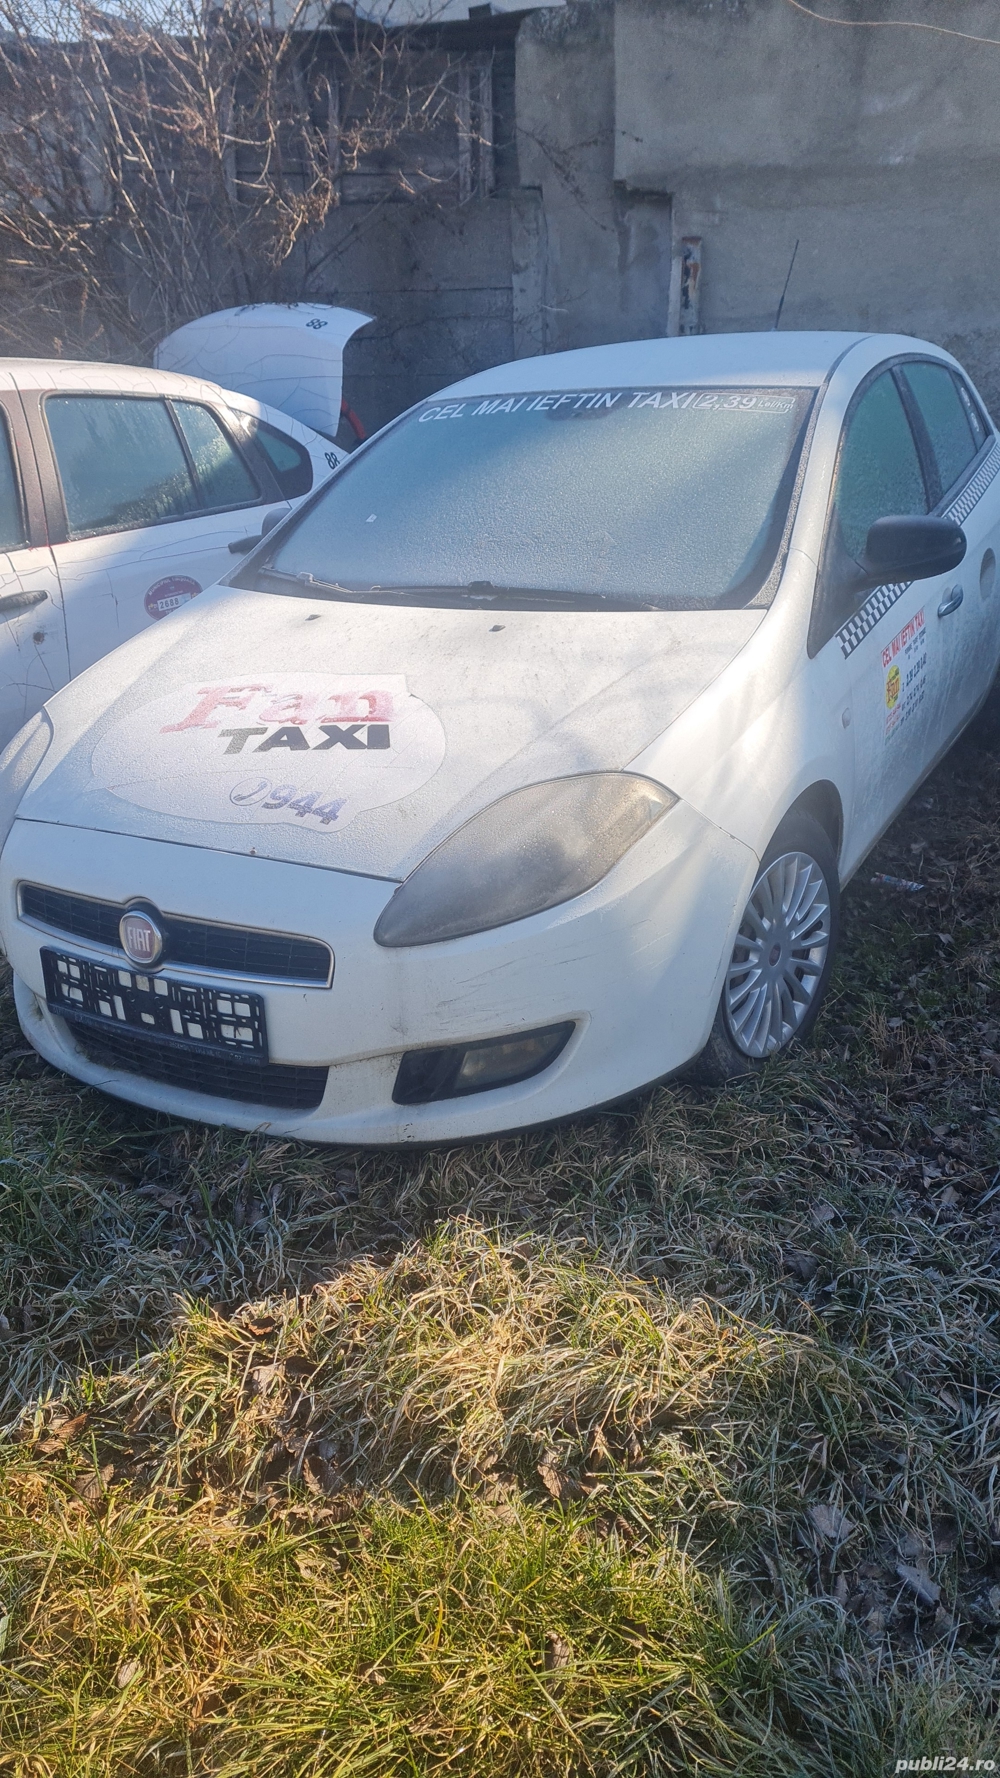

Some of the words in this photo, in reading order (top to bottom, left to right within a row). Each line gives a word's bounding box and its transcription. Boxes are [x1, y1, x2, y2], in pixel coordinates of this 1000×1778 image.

[305, 318, 328, 330] 88
[418, 403, 467, 422] CEL
[471, 397, 528, 416] MAI
[526, 392, 623, 411] IEFTIN
[627, 391, 697, 409] TAXI
[159, 598, 179, 609] 2688
[882, 646, 892, 668] CEL
[159, 683, 394, 734] Fan
[217, 724, 391, 755] TAXI
[261, 783, 350, 825] 944
[127, 926, 151, 952] FIAT
